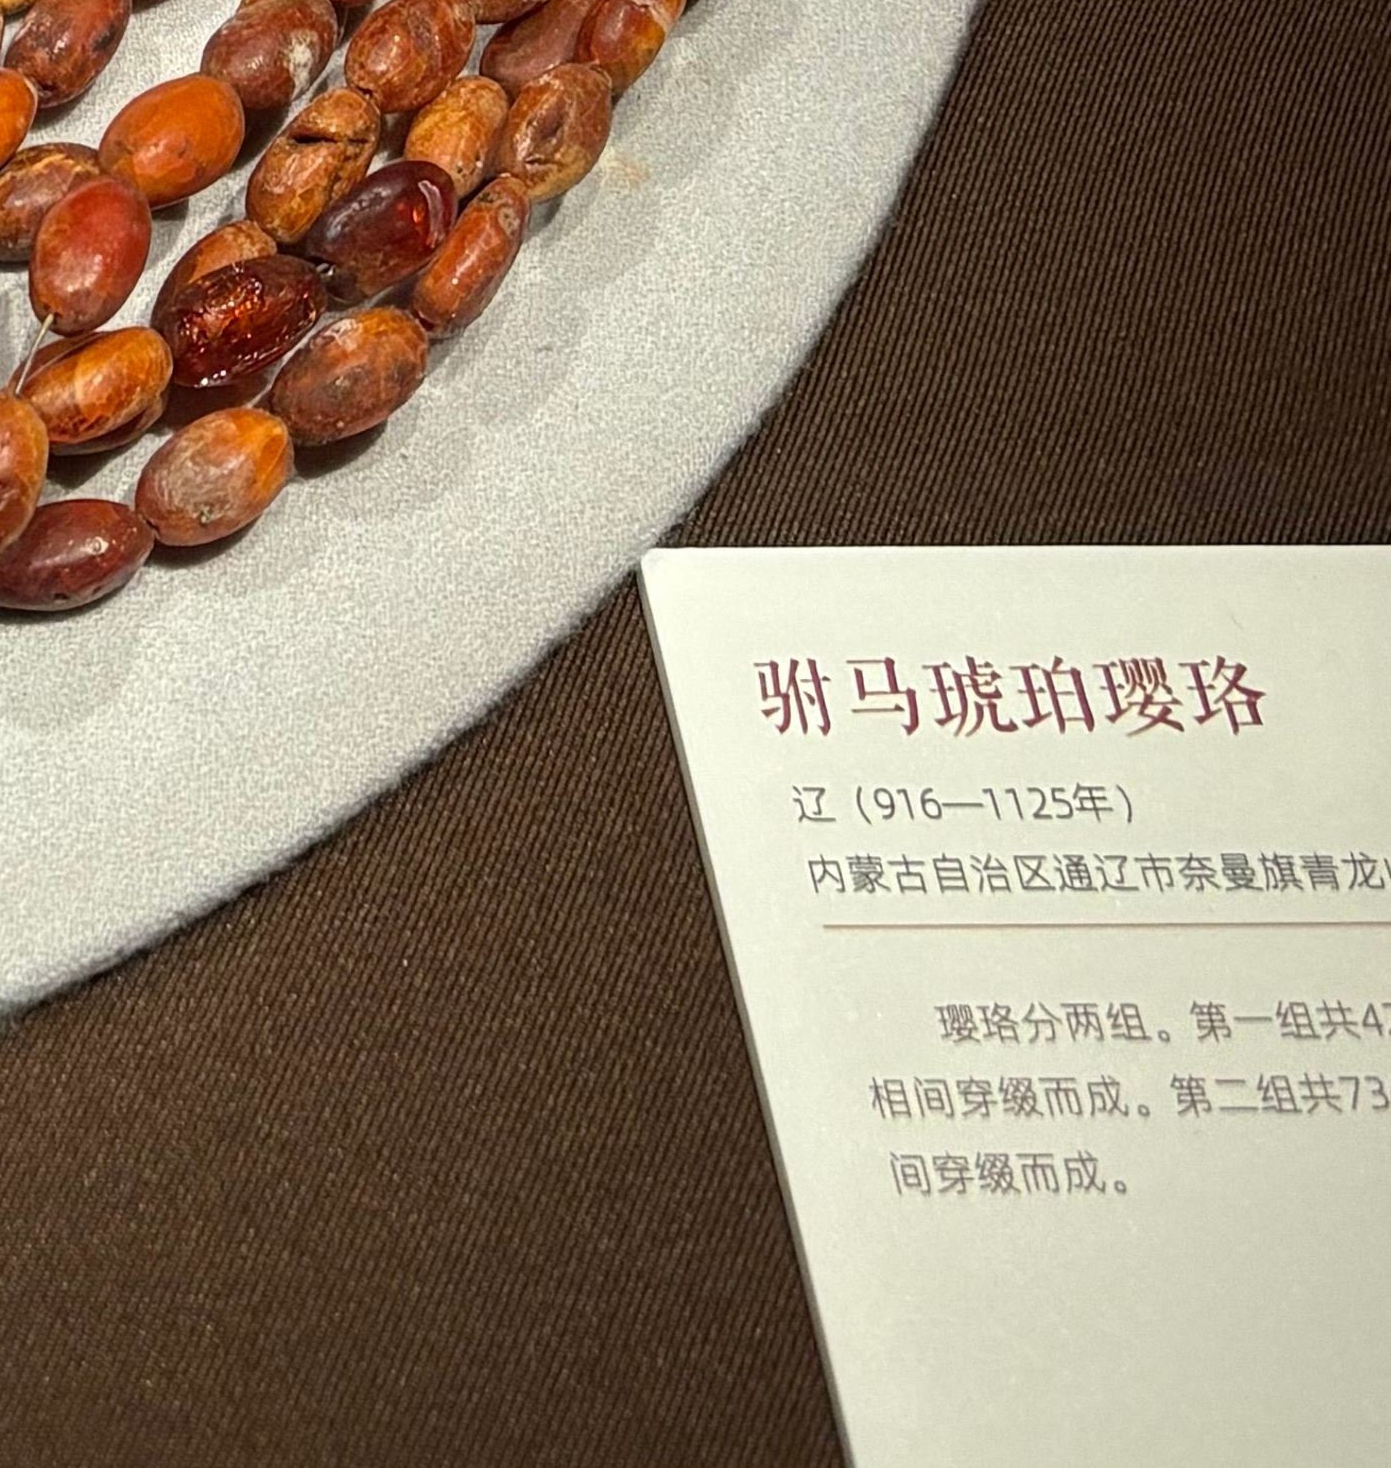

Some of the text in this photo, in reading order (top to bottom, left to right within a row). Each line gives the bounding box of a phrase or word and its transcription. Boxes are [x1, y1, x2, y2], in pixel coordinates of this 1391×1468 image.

[752, 654, 1267, 738] 驸马琥珀璎珞
[889, 1149, 1129, 1197] 间穿缀而成。
